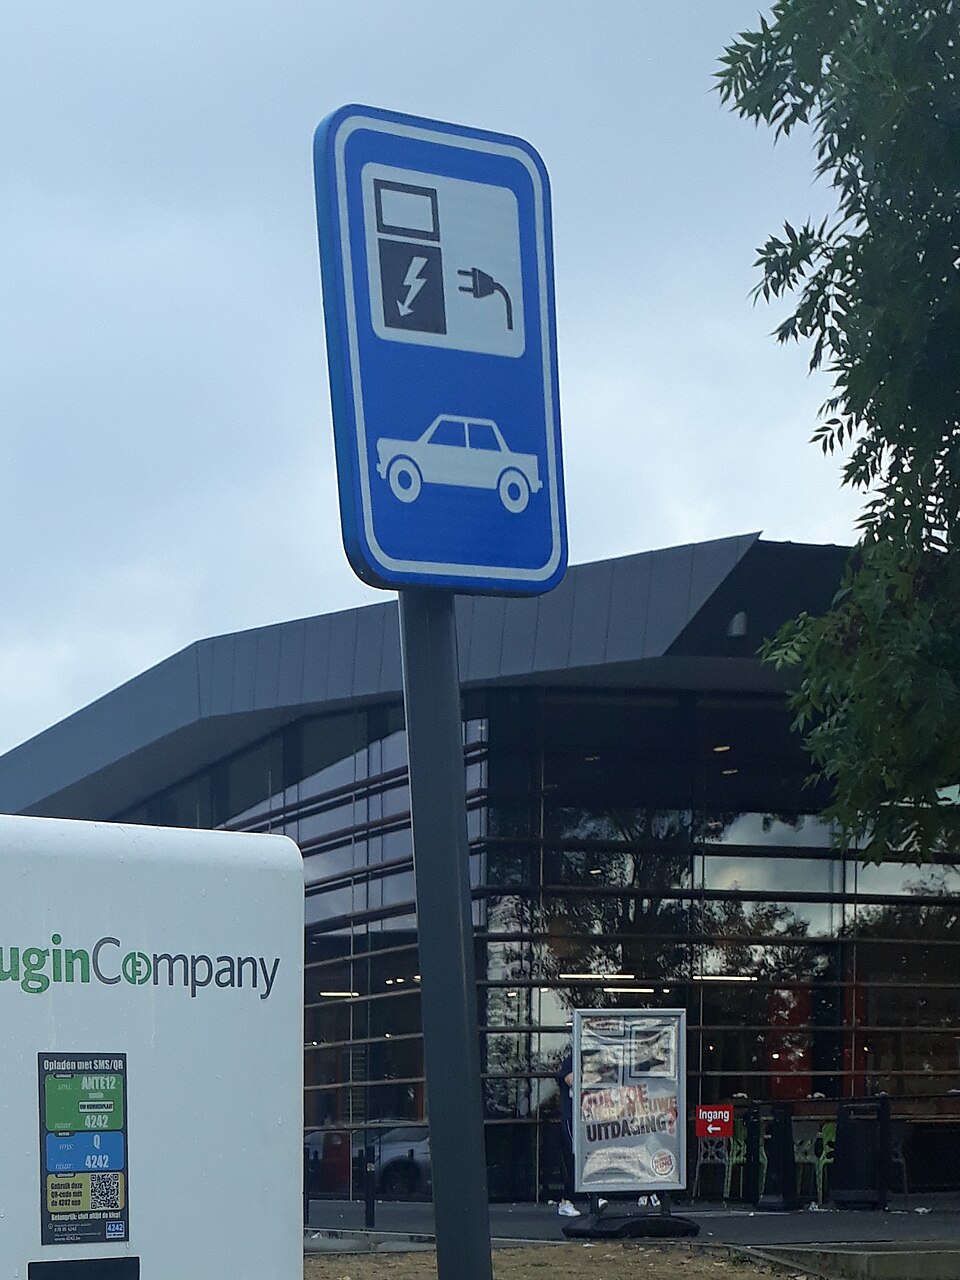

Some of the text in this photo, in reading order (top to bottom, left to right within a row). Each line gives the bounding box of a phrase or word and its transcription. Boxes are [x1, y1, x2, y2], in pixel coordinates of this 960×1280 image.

[43, 1060, 123, 1071] Opladen met SMS/QR
[81, 1076, 116, 1090] ANTE12
[85, 1114, 109, 1129] 4242
[699, 1109, 730, 1122] Ingang
[93, 1134, 101, 1150] Q
[85, 1154, 110, 1169] 4242
